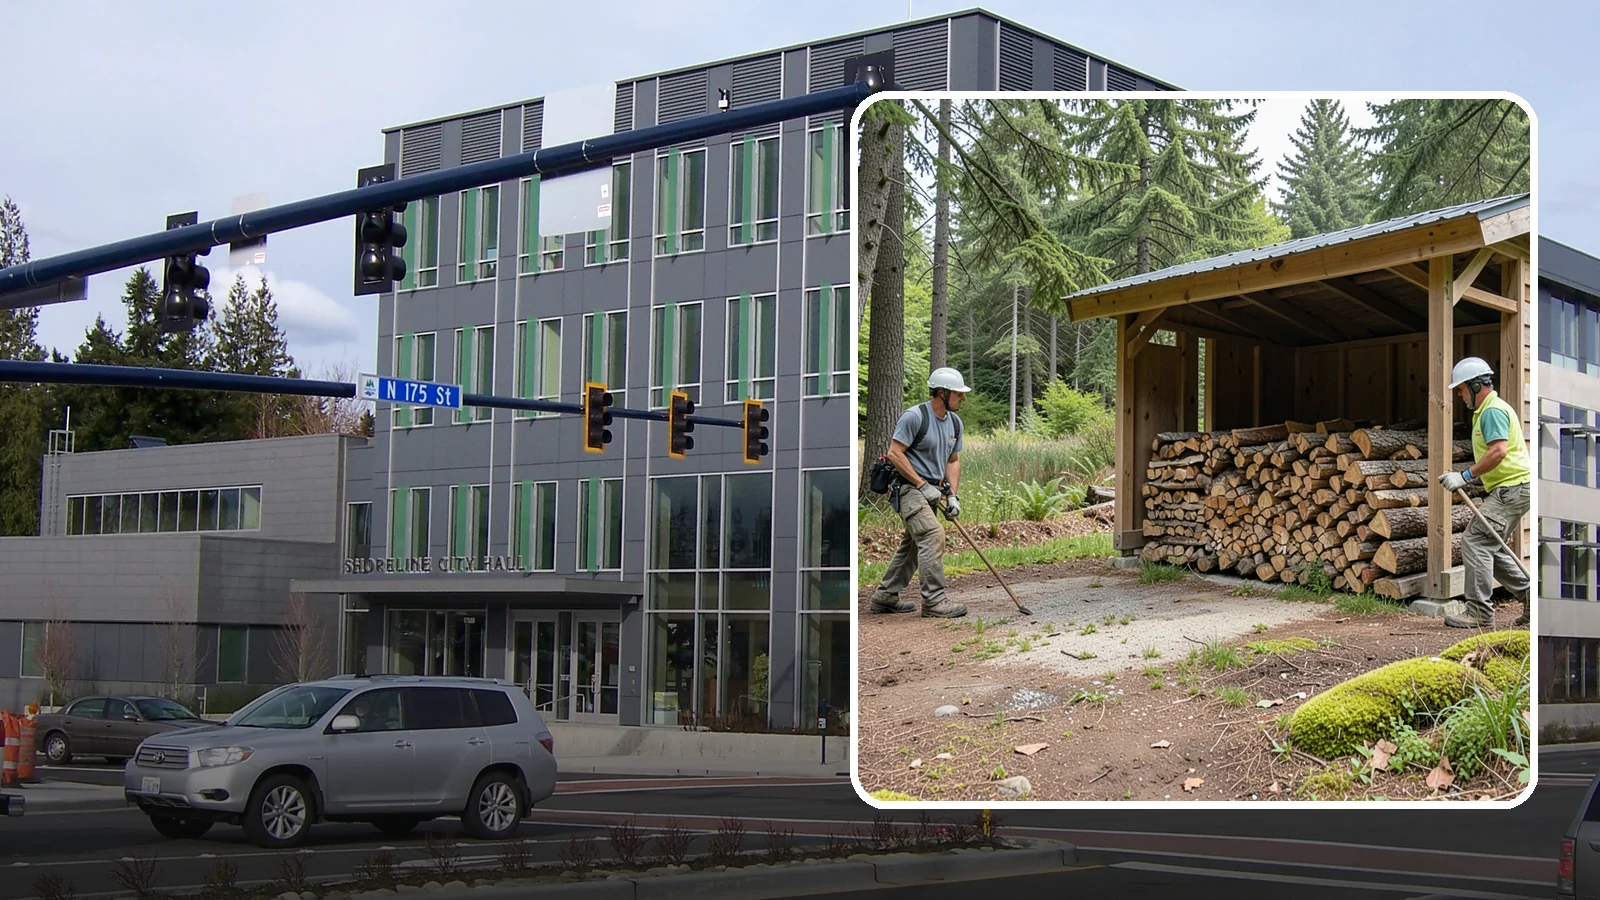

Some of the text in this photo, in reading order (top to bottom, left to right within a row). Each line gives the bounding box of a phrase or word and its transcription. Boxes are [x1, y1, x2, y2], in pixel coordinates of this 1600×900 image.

[387, 380, 451, 406] N 175 St
[344, 555, 525, 574] SHORELINE CITY HALL
